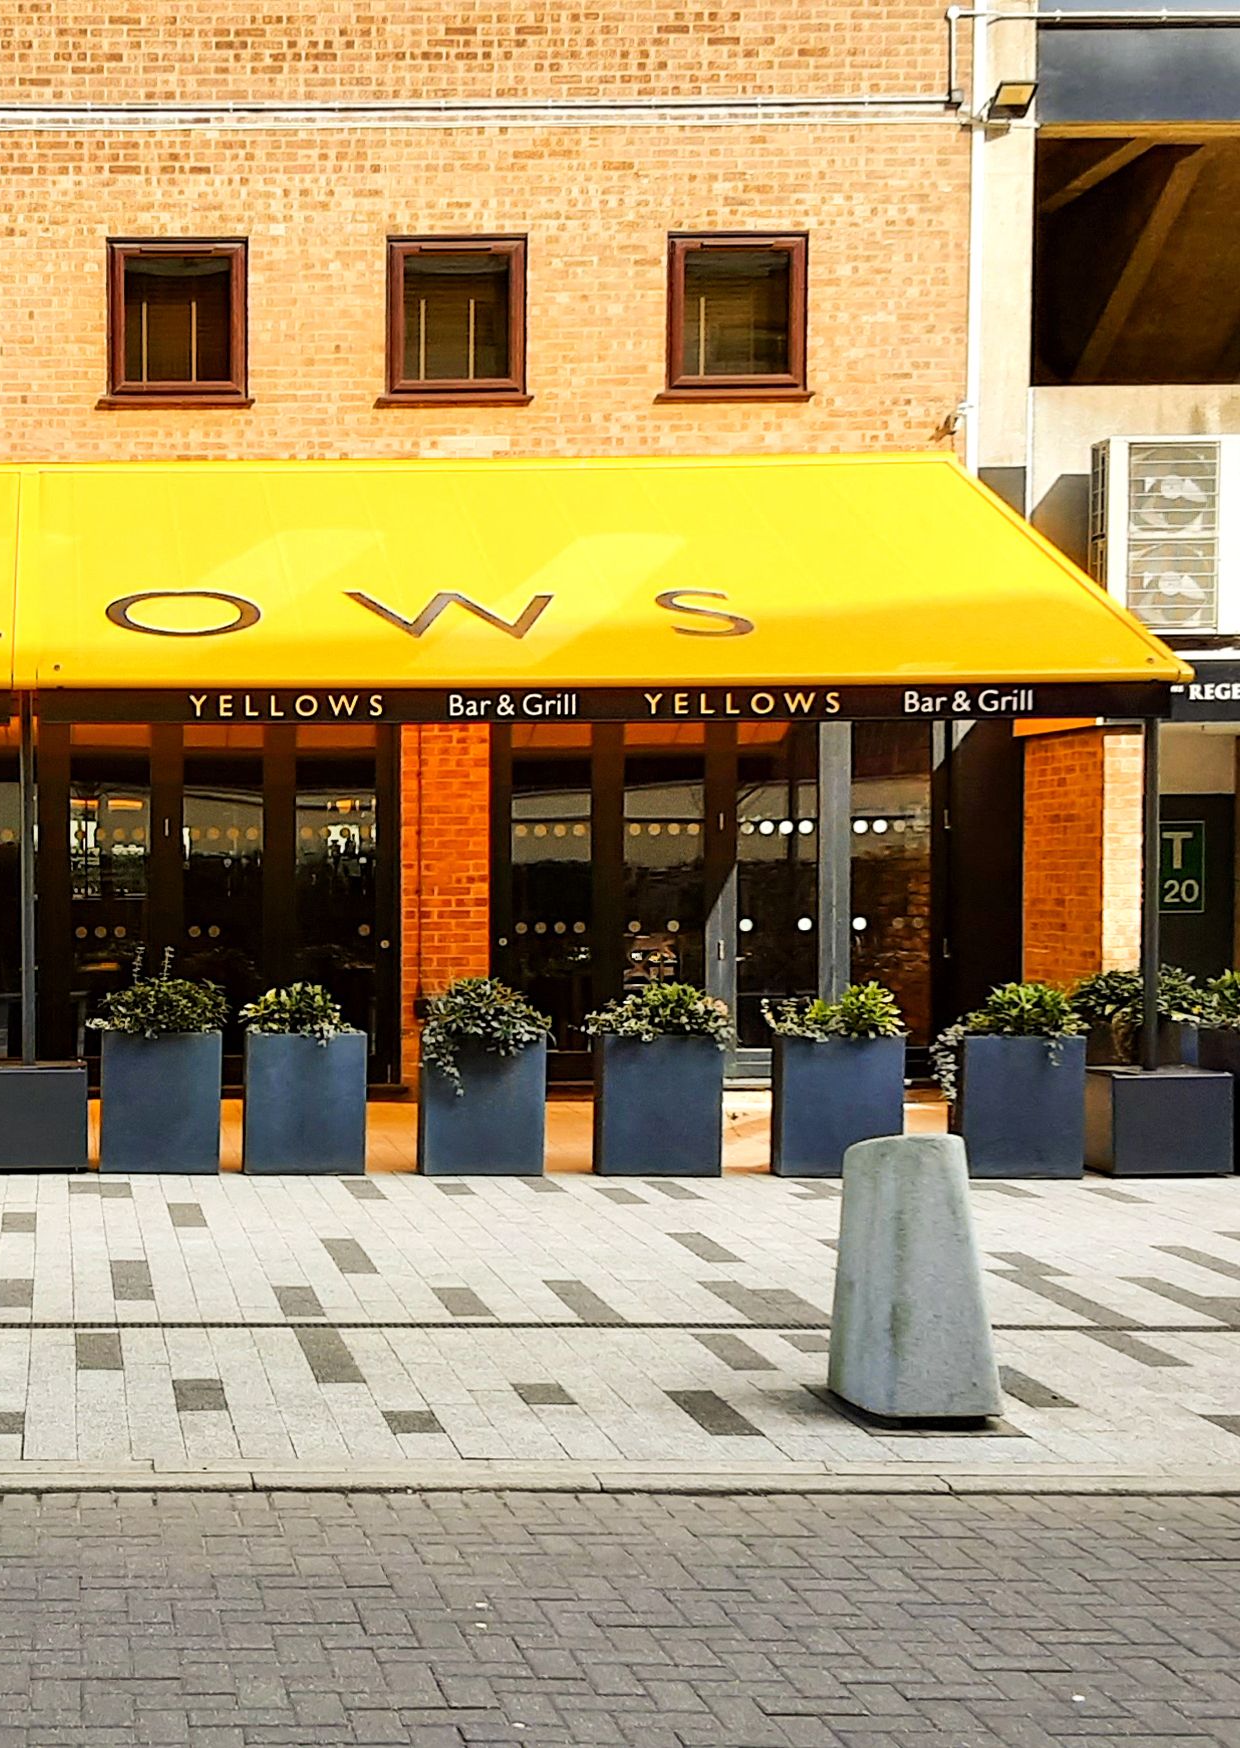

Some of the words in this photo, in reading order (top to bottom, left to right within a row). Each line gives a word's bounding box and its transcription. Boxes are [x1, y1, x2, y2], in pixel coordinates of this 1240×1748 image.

[188, 693, 384, 717] YELLOWS
[448, 693, 493, 717] Bar
[495, 693, 516, 716] &
[521, 692, 577, 716] Grill
[644, 691, 841, 714] YELLOWS
[903, 690, 949, 714] Bar
[950, 690, 972, 713] &
[977, 689, 1034, 713] Grill
[1188, 682, 1240, 701] REGE
[1162, 879, 1200, 904] 20
